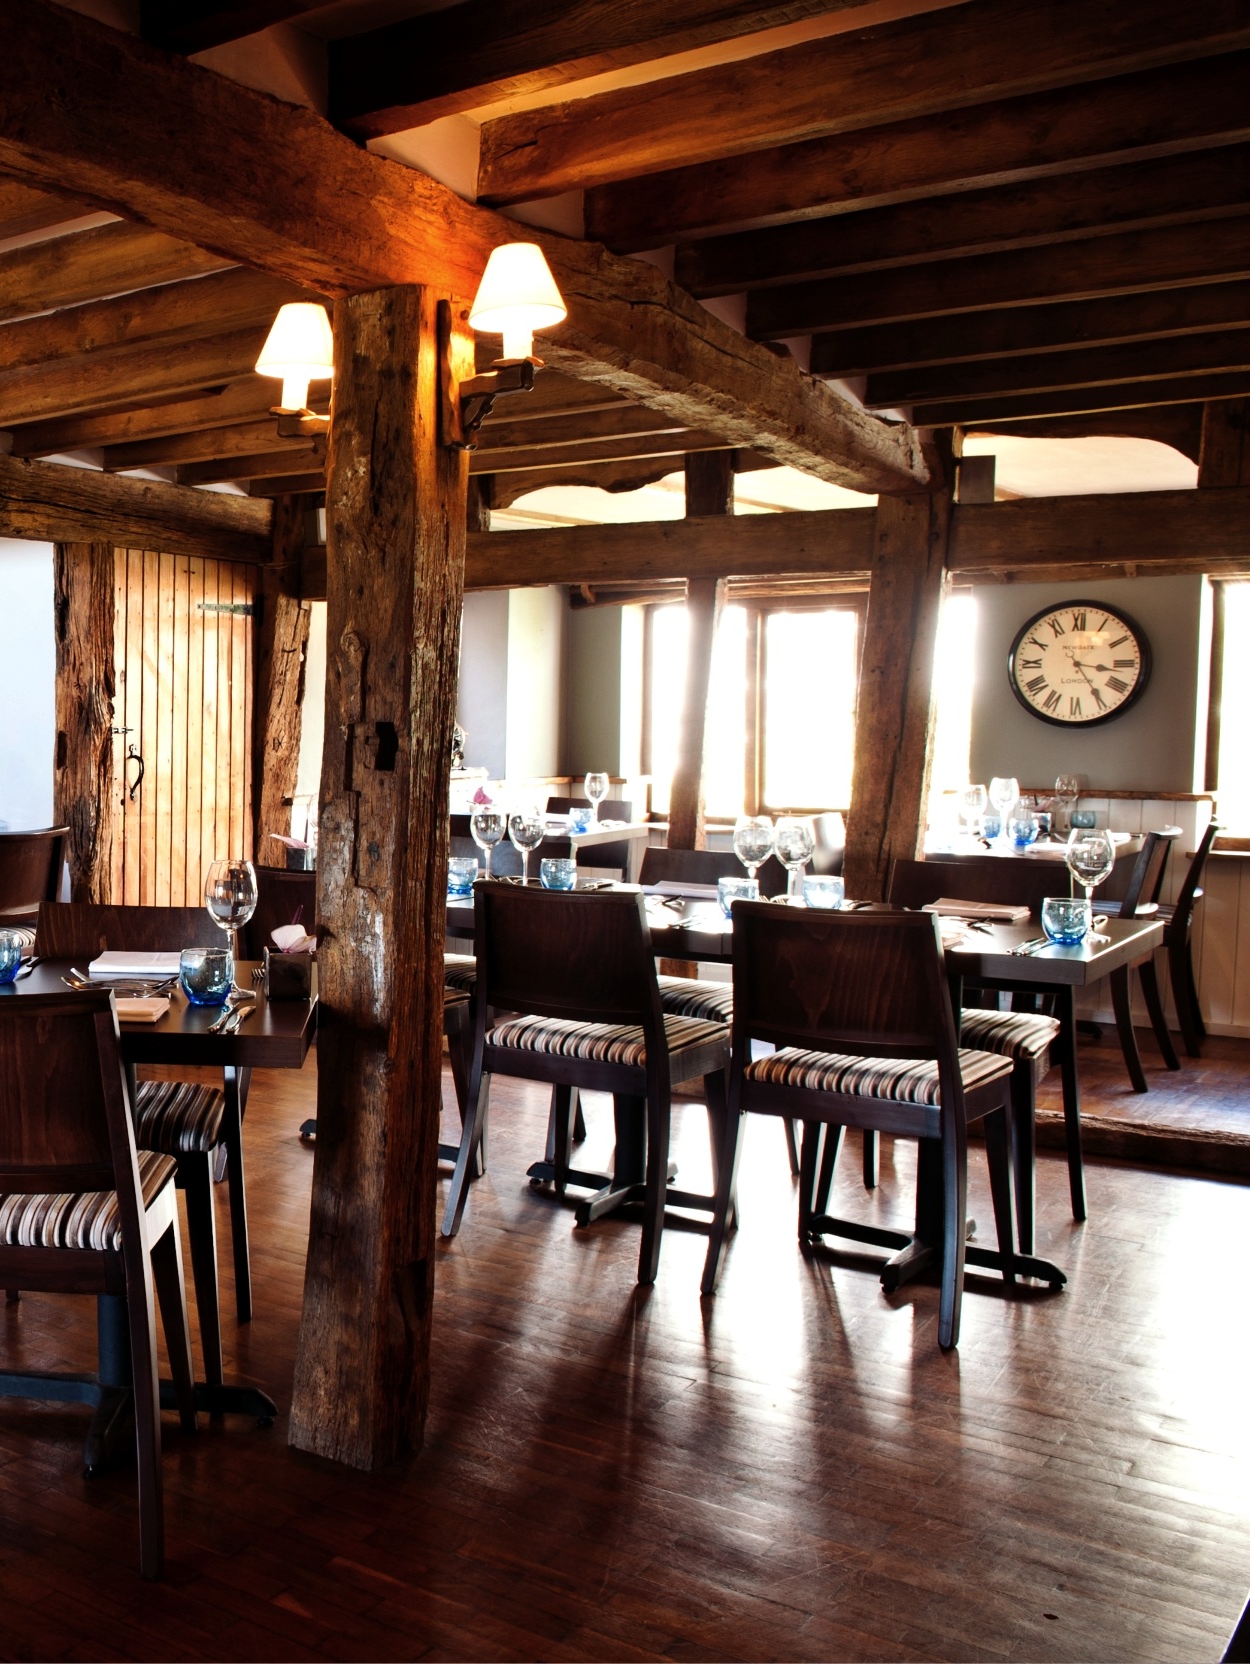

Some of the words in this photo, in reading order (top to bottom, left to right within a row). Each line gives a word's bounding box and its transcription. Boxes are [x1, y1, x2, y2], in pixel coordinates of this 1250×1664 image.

[1047, 618, 1065, 638] XI
[1072, 613, 1086, 631] XII
[1028, 637, 1048, 651] X
[1109, 635, 1129, 649] II
[1022, 659, 1042, 668] IX
[1113, 660, 1135, 668] III
[1026, 675, 1048, 696] VIII
[1105, 676, 1128, 694] IIII
[1043, 690, 1062, 711] VII
[1070, 697, 1081, 716] VI
